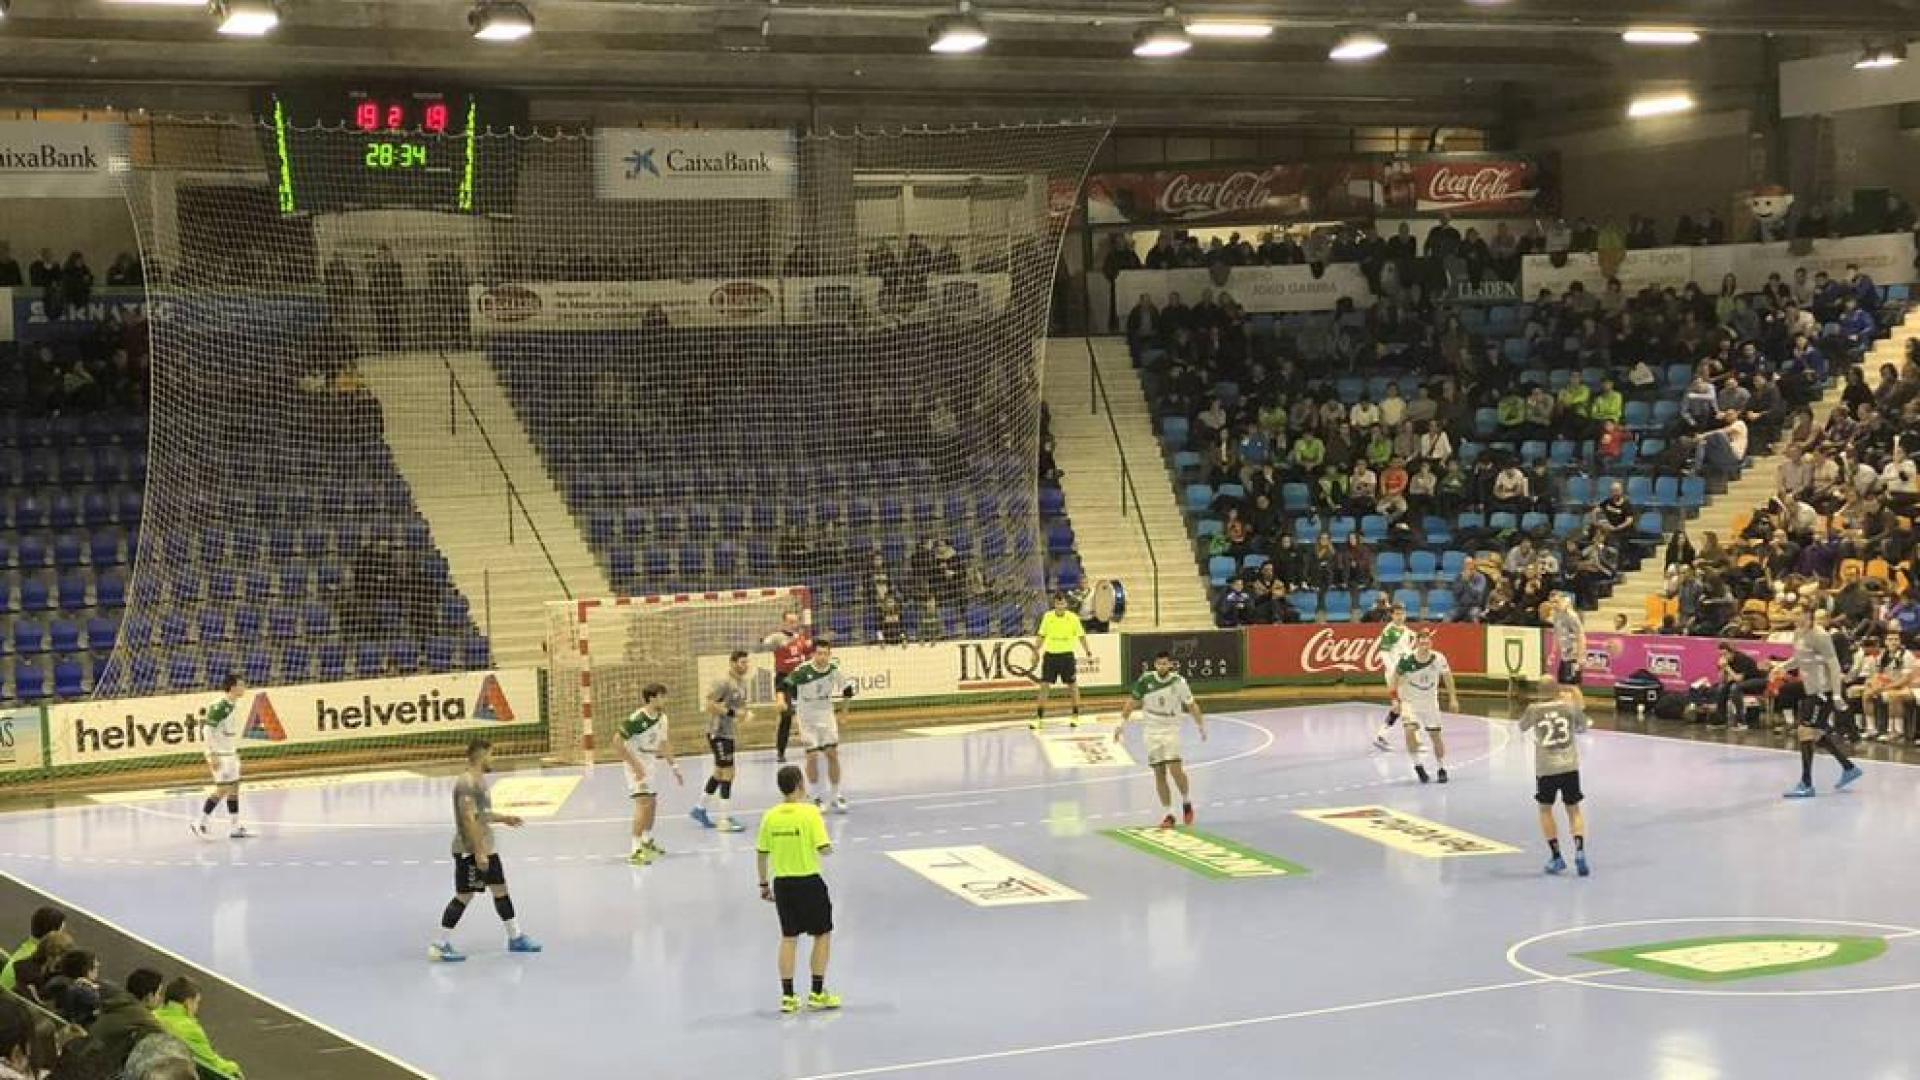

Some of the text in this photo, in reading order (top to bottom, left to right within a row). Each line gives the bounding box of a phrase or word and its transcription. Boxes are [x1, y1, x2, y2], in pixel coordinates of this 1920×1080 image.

[356, 103, 448, 134] 19 2 19
[365, 143, 427, 167] 28:34
[666, 148, 771, 172] CaixaBank
[959, 639, 1042, 683] IMQ
[316, 688, 466, 732] helvetia
[75, 706, 210, 752] helveti
[1538, 716, 1569, 746] 23
